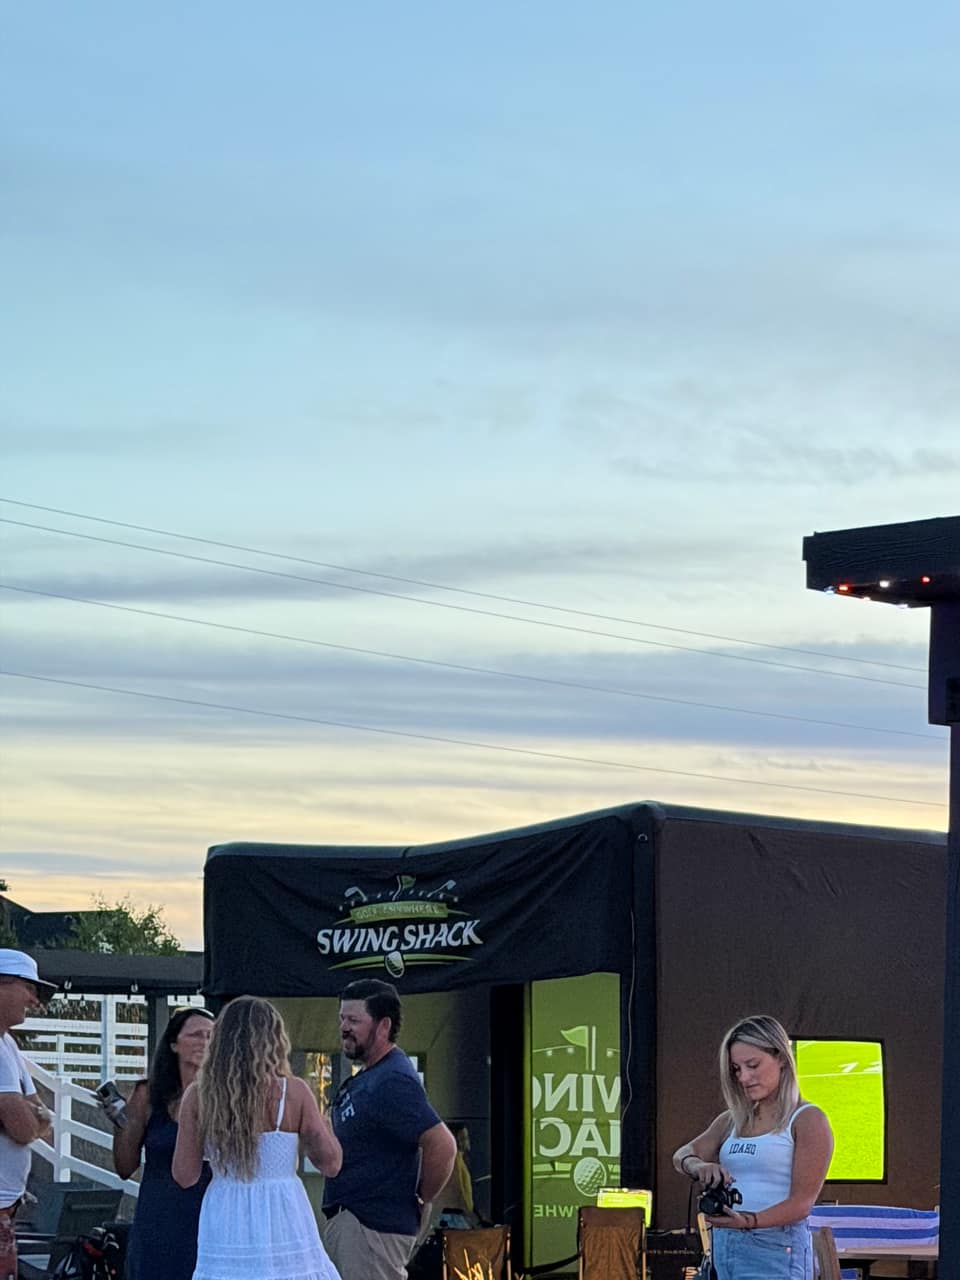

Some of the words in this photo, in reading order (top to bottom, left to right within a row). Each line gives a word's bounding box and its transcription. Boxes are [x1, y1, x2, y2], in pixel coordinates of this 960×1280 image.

[317, 926, 399, 954] SWING
[401, 919, 484, 950] SHACK
[728, 1143, 757, 1155] IDAHO
